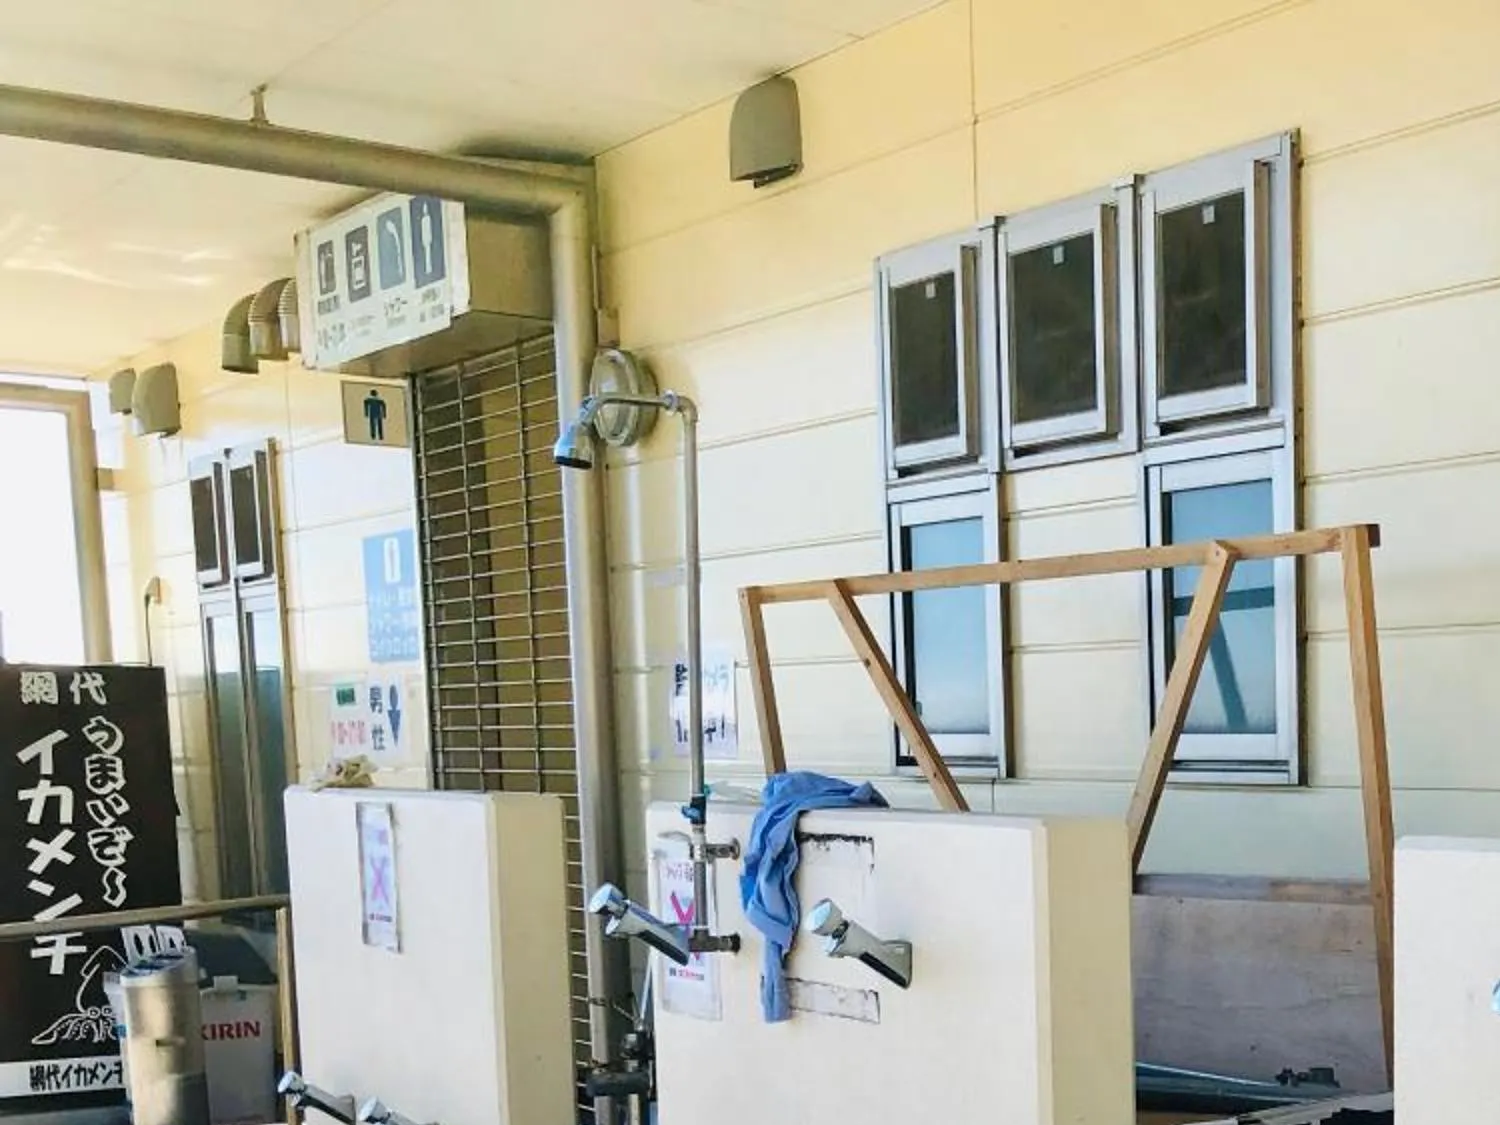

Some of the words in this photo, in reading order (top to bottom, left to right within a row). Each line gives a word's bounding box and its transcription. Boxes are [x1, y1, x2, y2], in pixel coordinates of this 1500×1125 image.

[20, 671, 107, 705] 網代
[16, 729, 87, 975] イカメンチ
